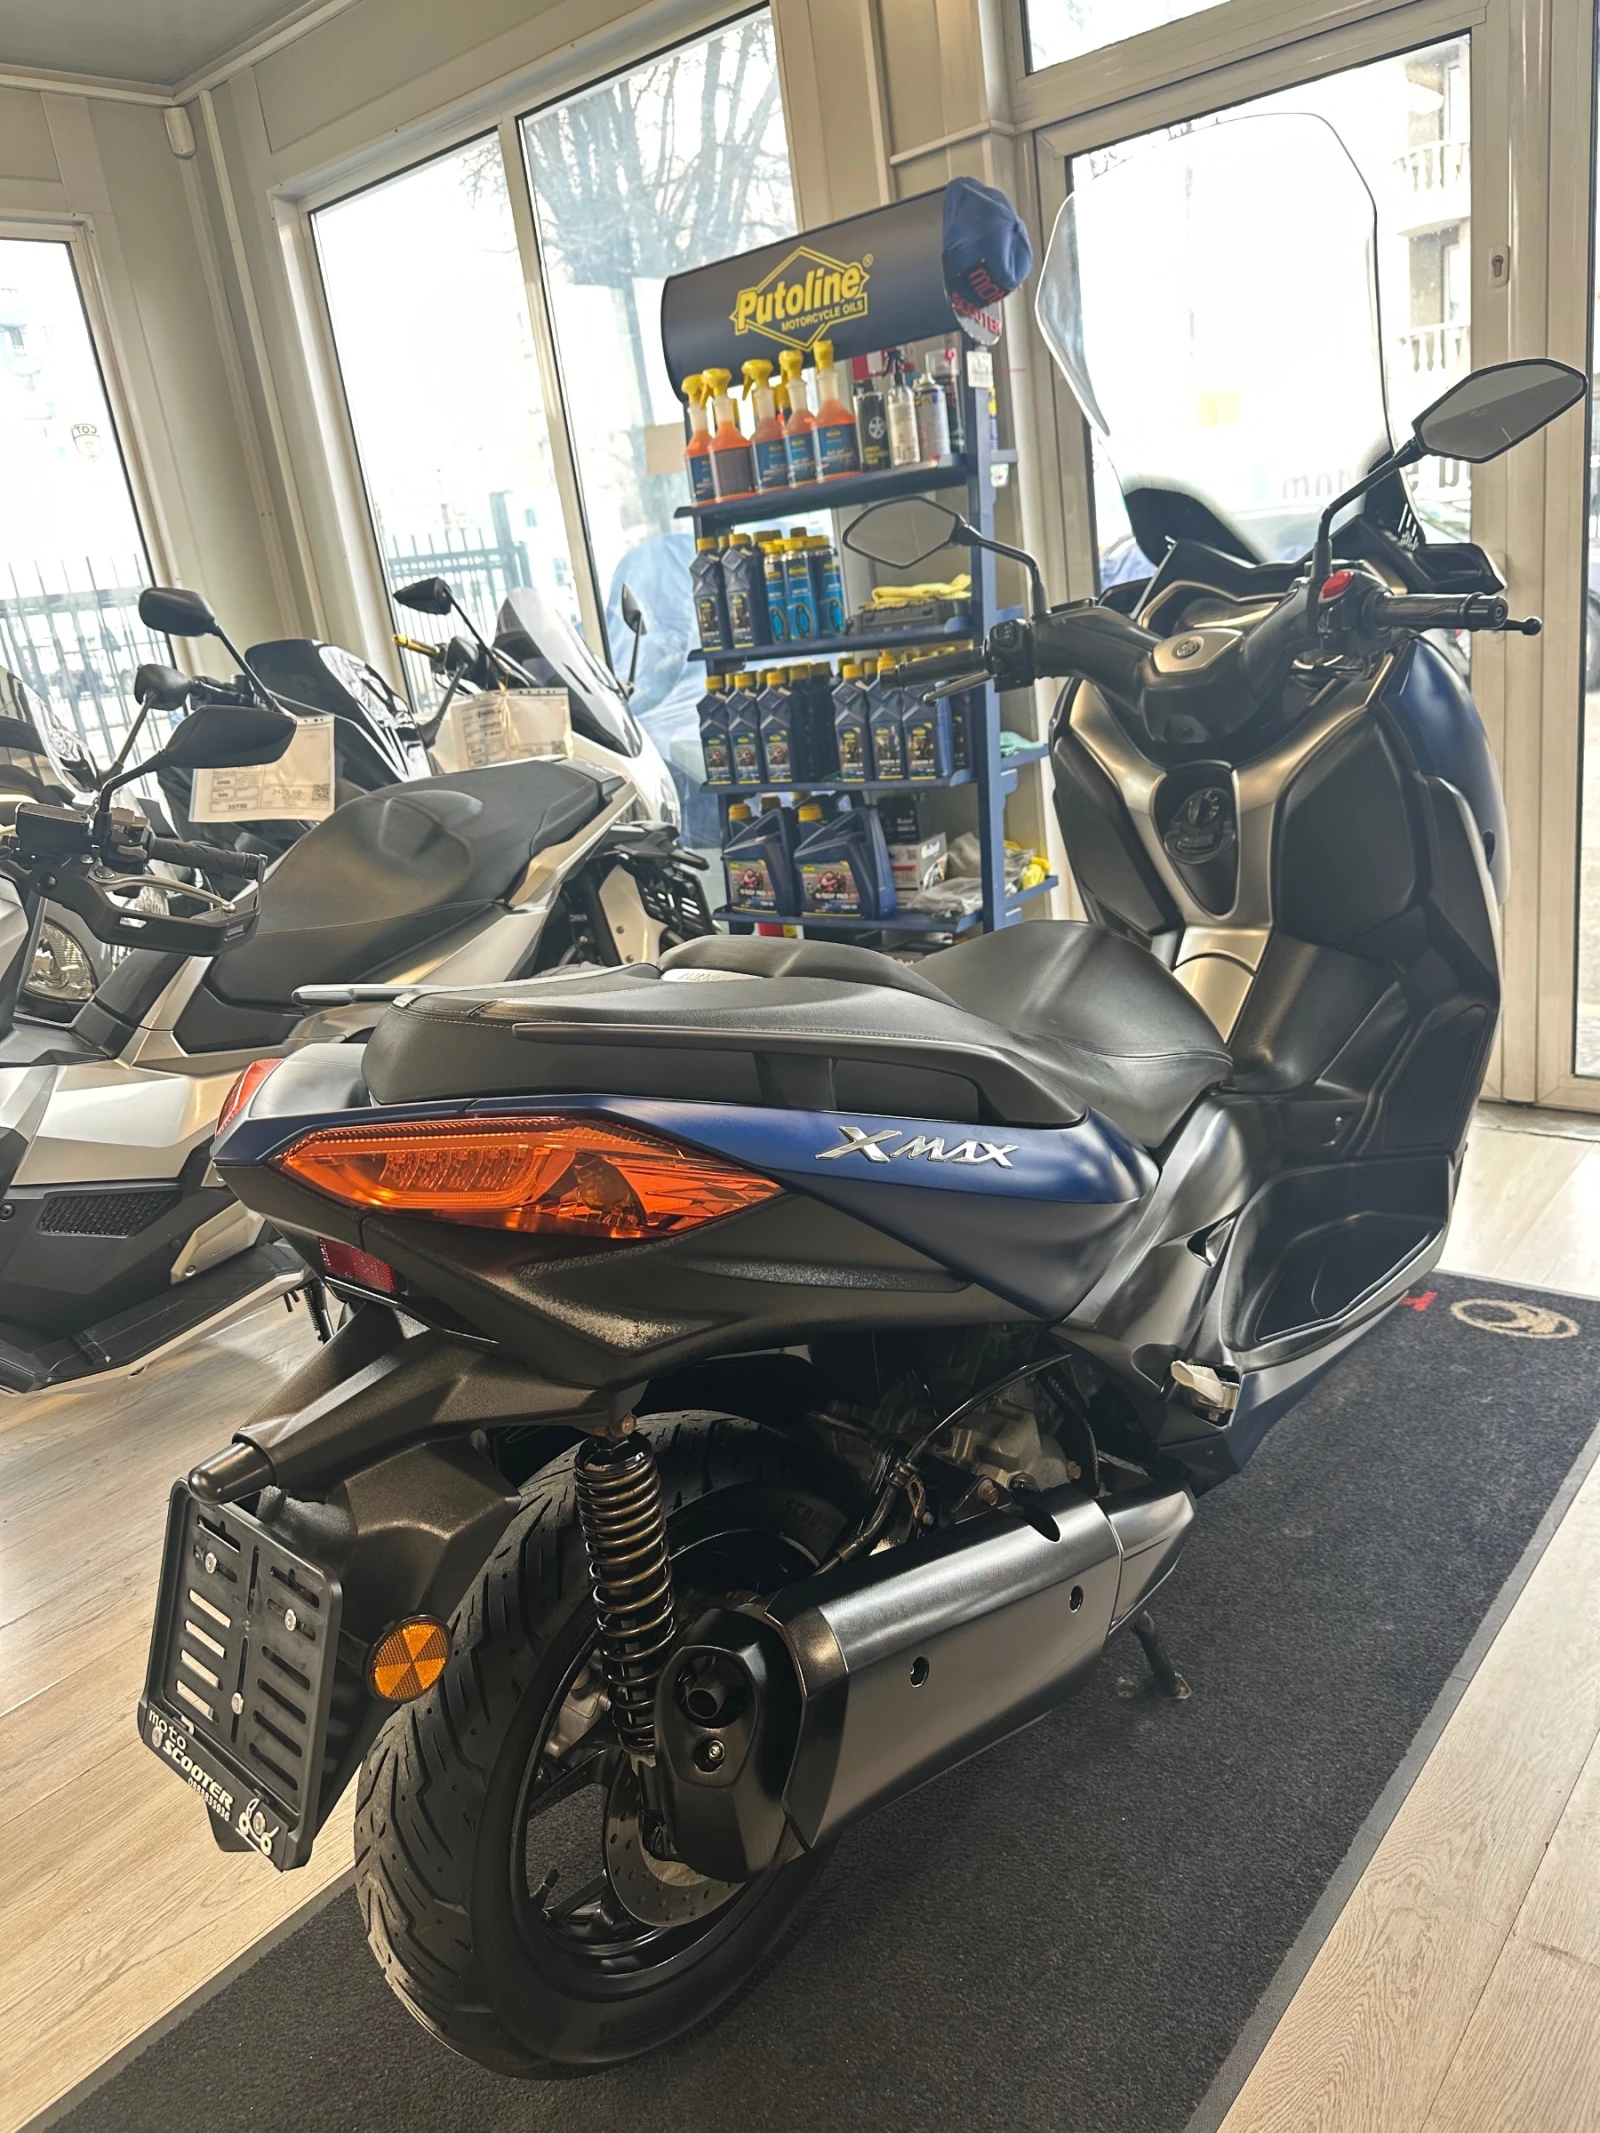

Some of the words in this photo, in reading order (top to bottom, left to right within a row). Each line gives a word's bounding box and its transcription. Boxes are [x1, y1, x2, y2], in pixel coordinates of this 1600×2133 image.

[737, 265, 861, 331] Putoline
[781, 306, 842, 333] MOTORCYCLE
[842, 299, 864, 315] OILS
[148, 1709, 188, 1750] moto
[162, 1740, 234, 1811] SCOOTER
